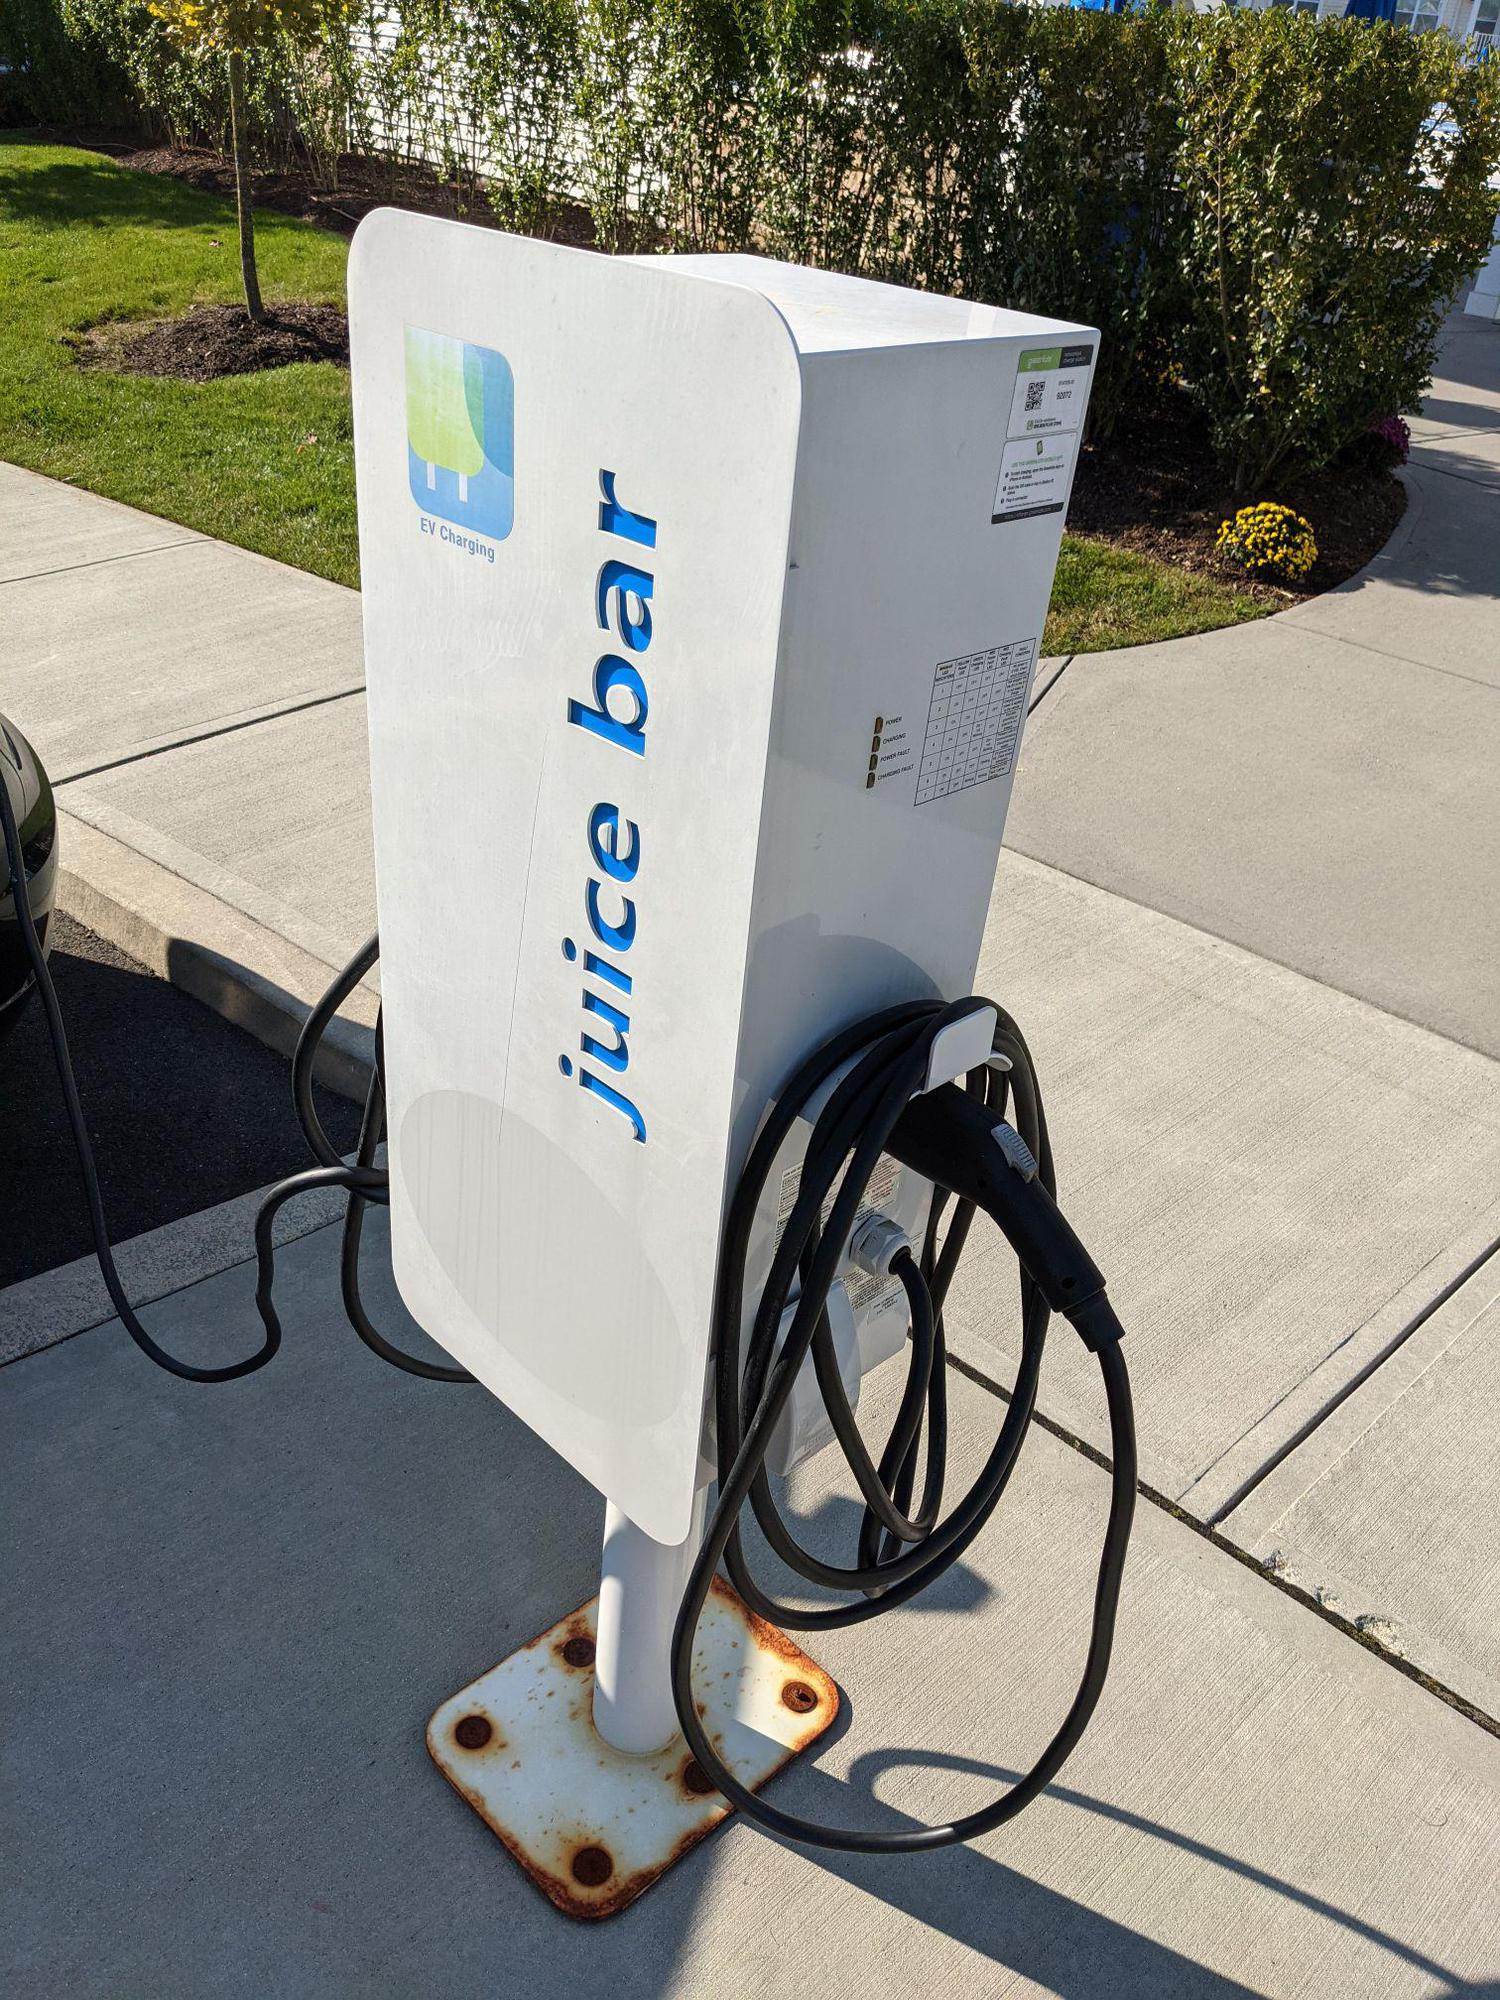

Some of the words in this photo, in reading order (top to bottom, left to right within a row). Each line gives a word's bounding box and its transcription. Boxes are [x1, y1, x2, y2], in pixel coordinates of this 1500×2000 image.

[420, 517, 436, 536] EV
[440, 525, 494, 563] Charging
[567, 468, 657, 760] bar
[558, 802, 647, 1145] juice
